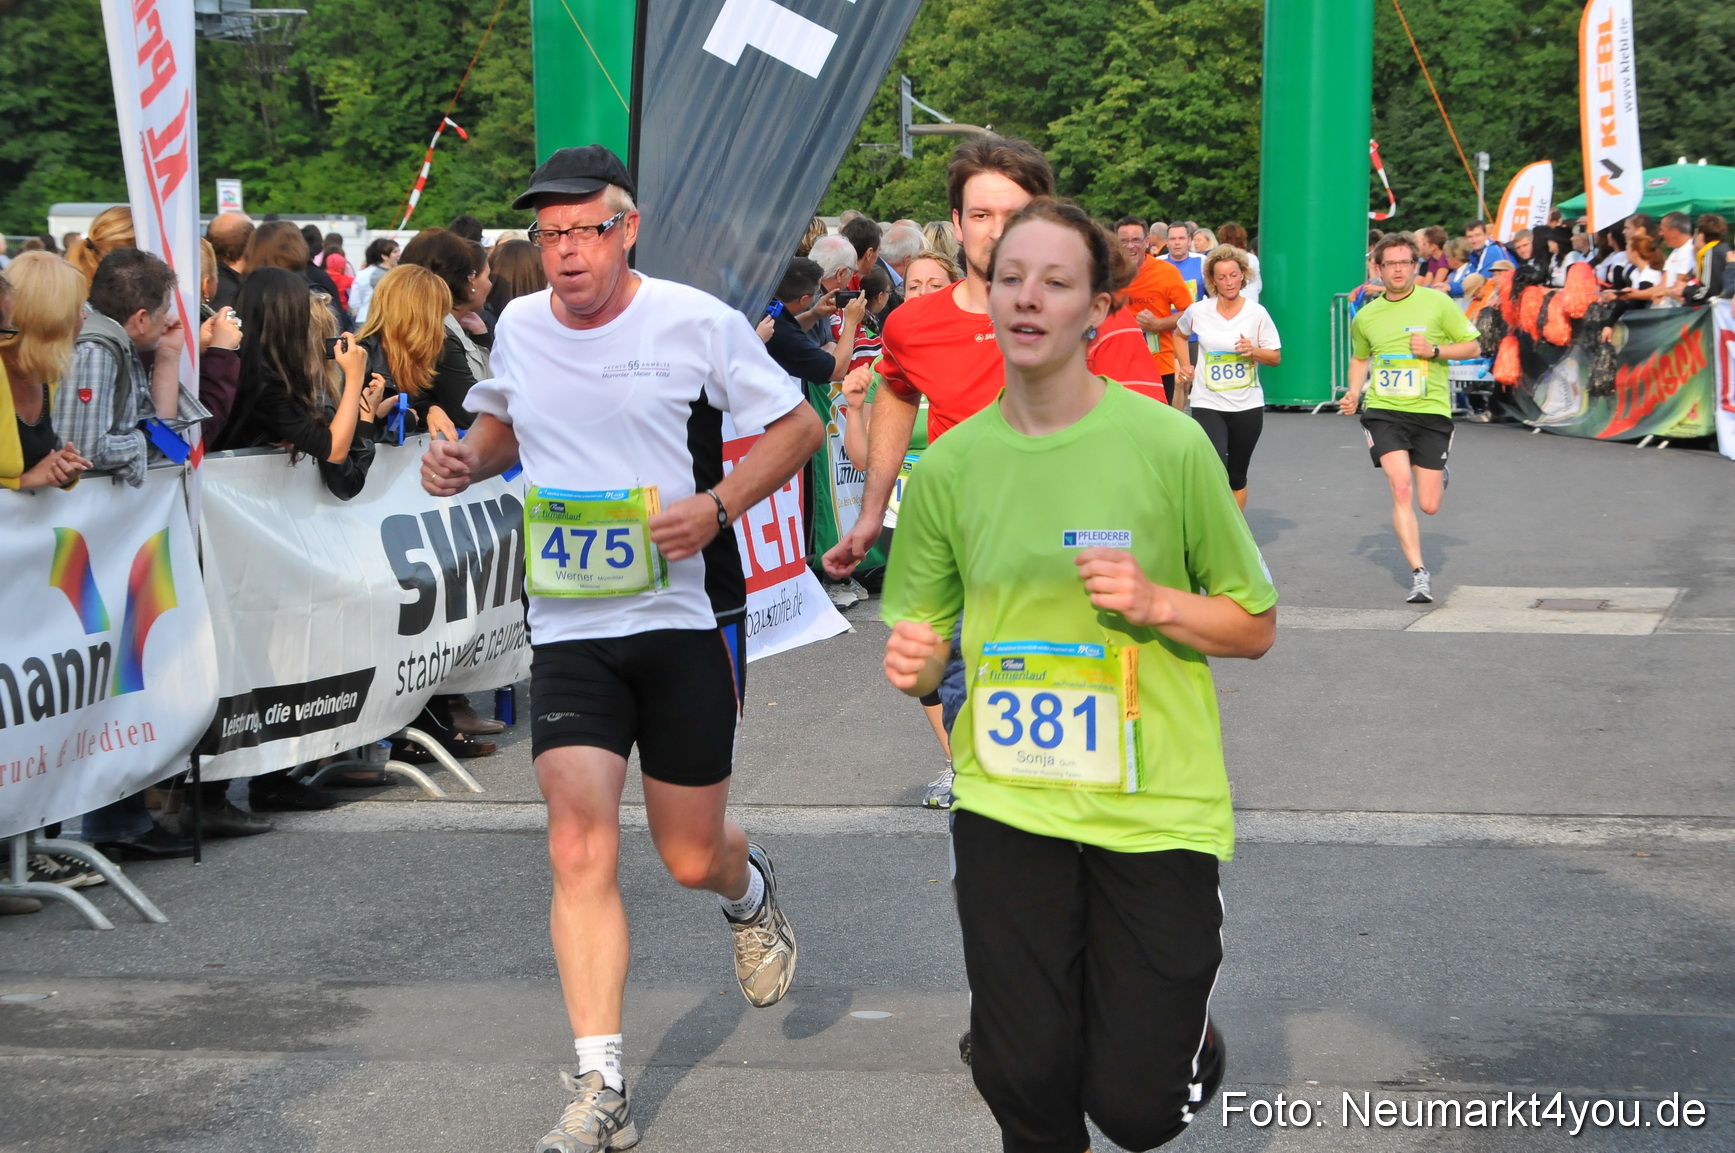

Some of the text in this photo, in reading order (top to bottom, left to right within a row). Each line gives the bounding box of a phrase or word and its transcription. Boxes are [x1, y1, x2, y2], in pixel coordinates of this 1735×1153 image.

[1597, 7, 1617, 148] KLEBL
[1619, 17, 1634, 114] www.klebl.de
[1509, 185, 1534, 239] BL
[1211, 363, 1245, 381] 868
[1380, 370, 1412, 387] 371
[542, 510, 582, 521] firmenlauf
[541, 527, 634, 569] 475
[1078, 531, 1130, 540] PFLEIDERER
[380, 493, 525, 637] swn
[556, 571, 593, 581] Werner
[989, 670, 1047, 681] firmenlauf
[265, 703, 291, 725] die
[295, 692, 358, 721] verbinden
[987, 690, 1097, 752] 381
[72, 719, 156, 762] Medien
[1017, 751, 1055, 766] Sonja
